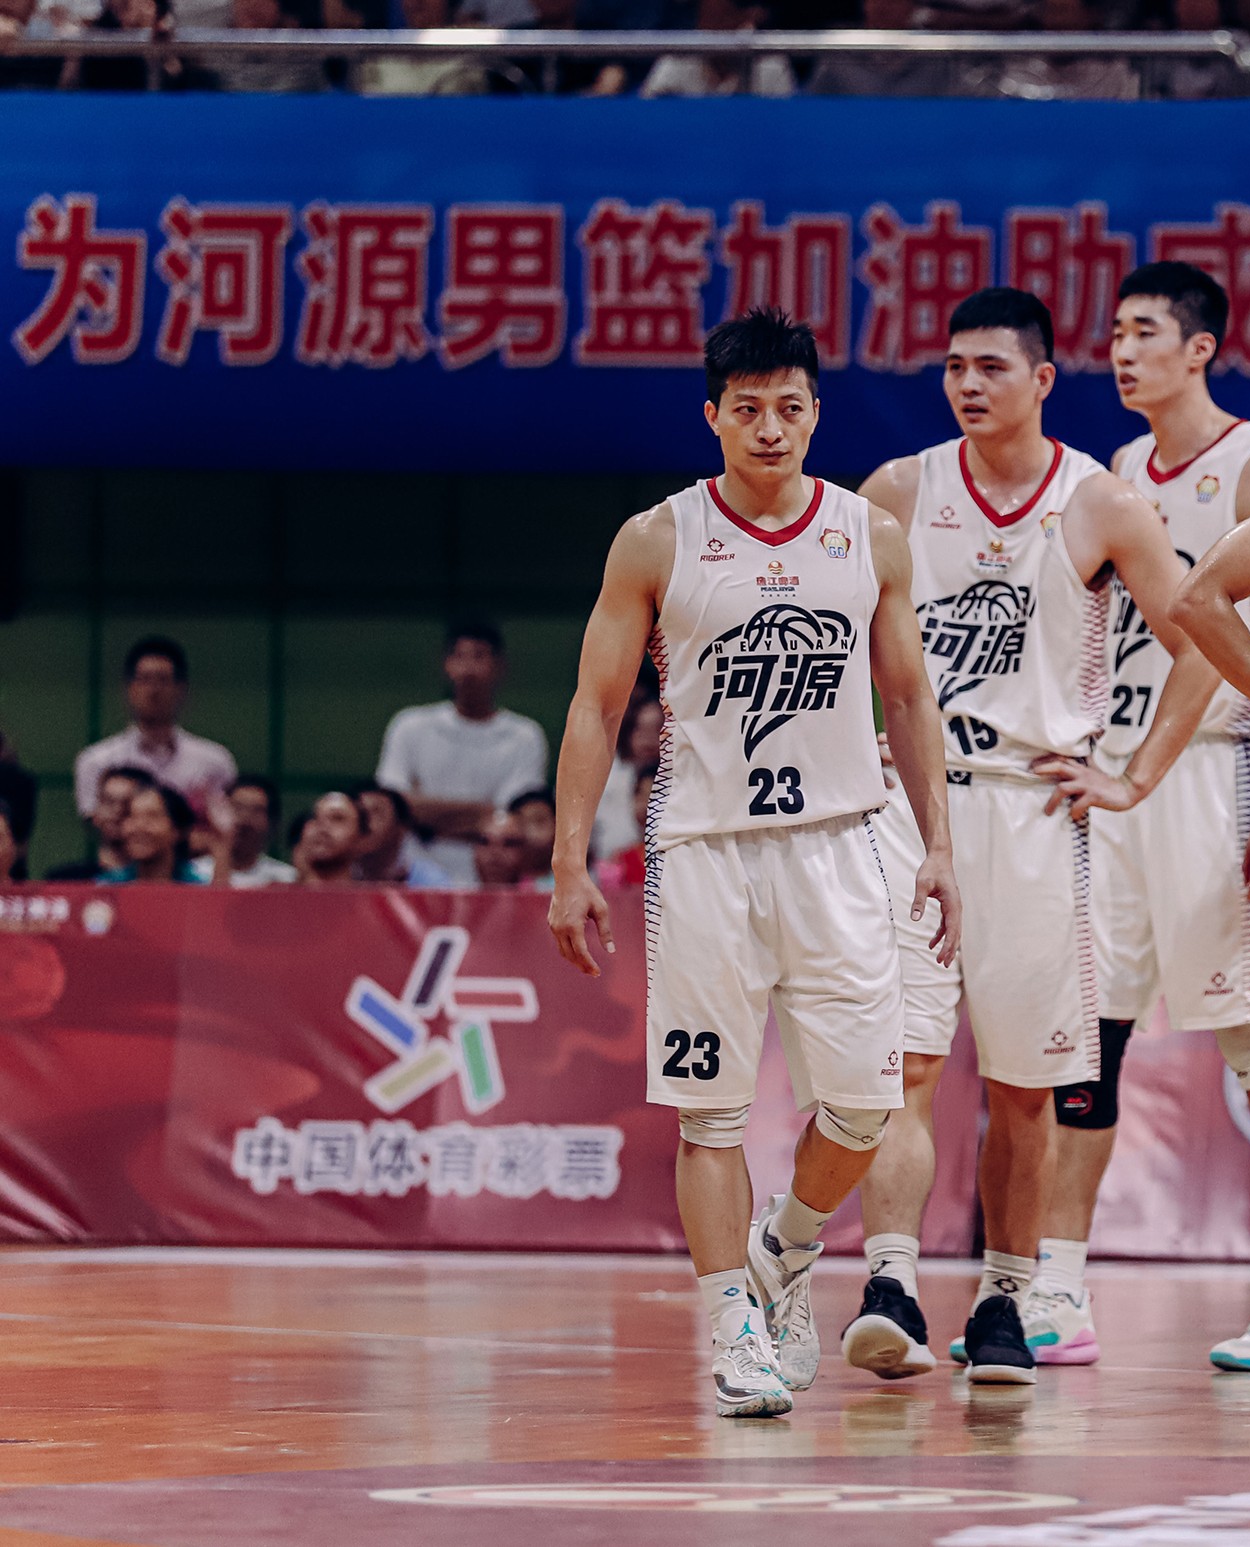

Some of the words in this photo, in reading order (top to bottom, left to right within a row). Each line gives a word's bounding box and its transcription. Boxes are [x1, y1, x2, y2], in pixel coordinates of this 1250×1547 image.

[699, 553, 736, 562] RIGORER
[714, 639, 849, 655] HEYUAN
[921, 618, 1027, 675] 河源
[704, 653, 849, 718] 河源
[1110, 685, 1152, 727] 27
[948, 715, 998, 755] 15
[749, 766, 805, 816] 23
[662, 1029, 721, 1081] 23
[235, 1119, 621, 1199] 中国体育彩票
